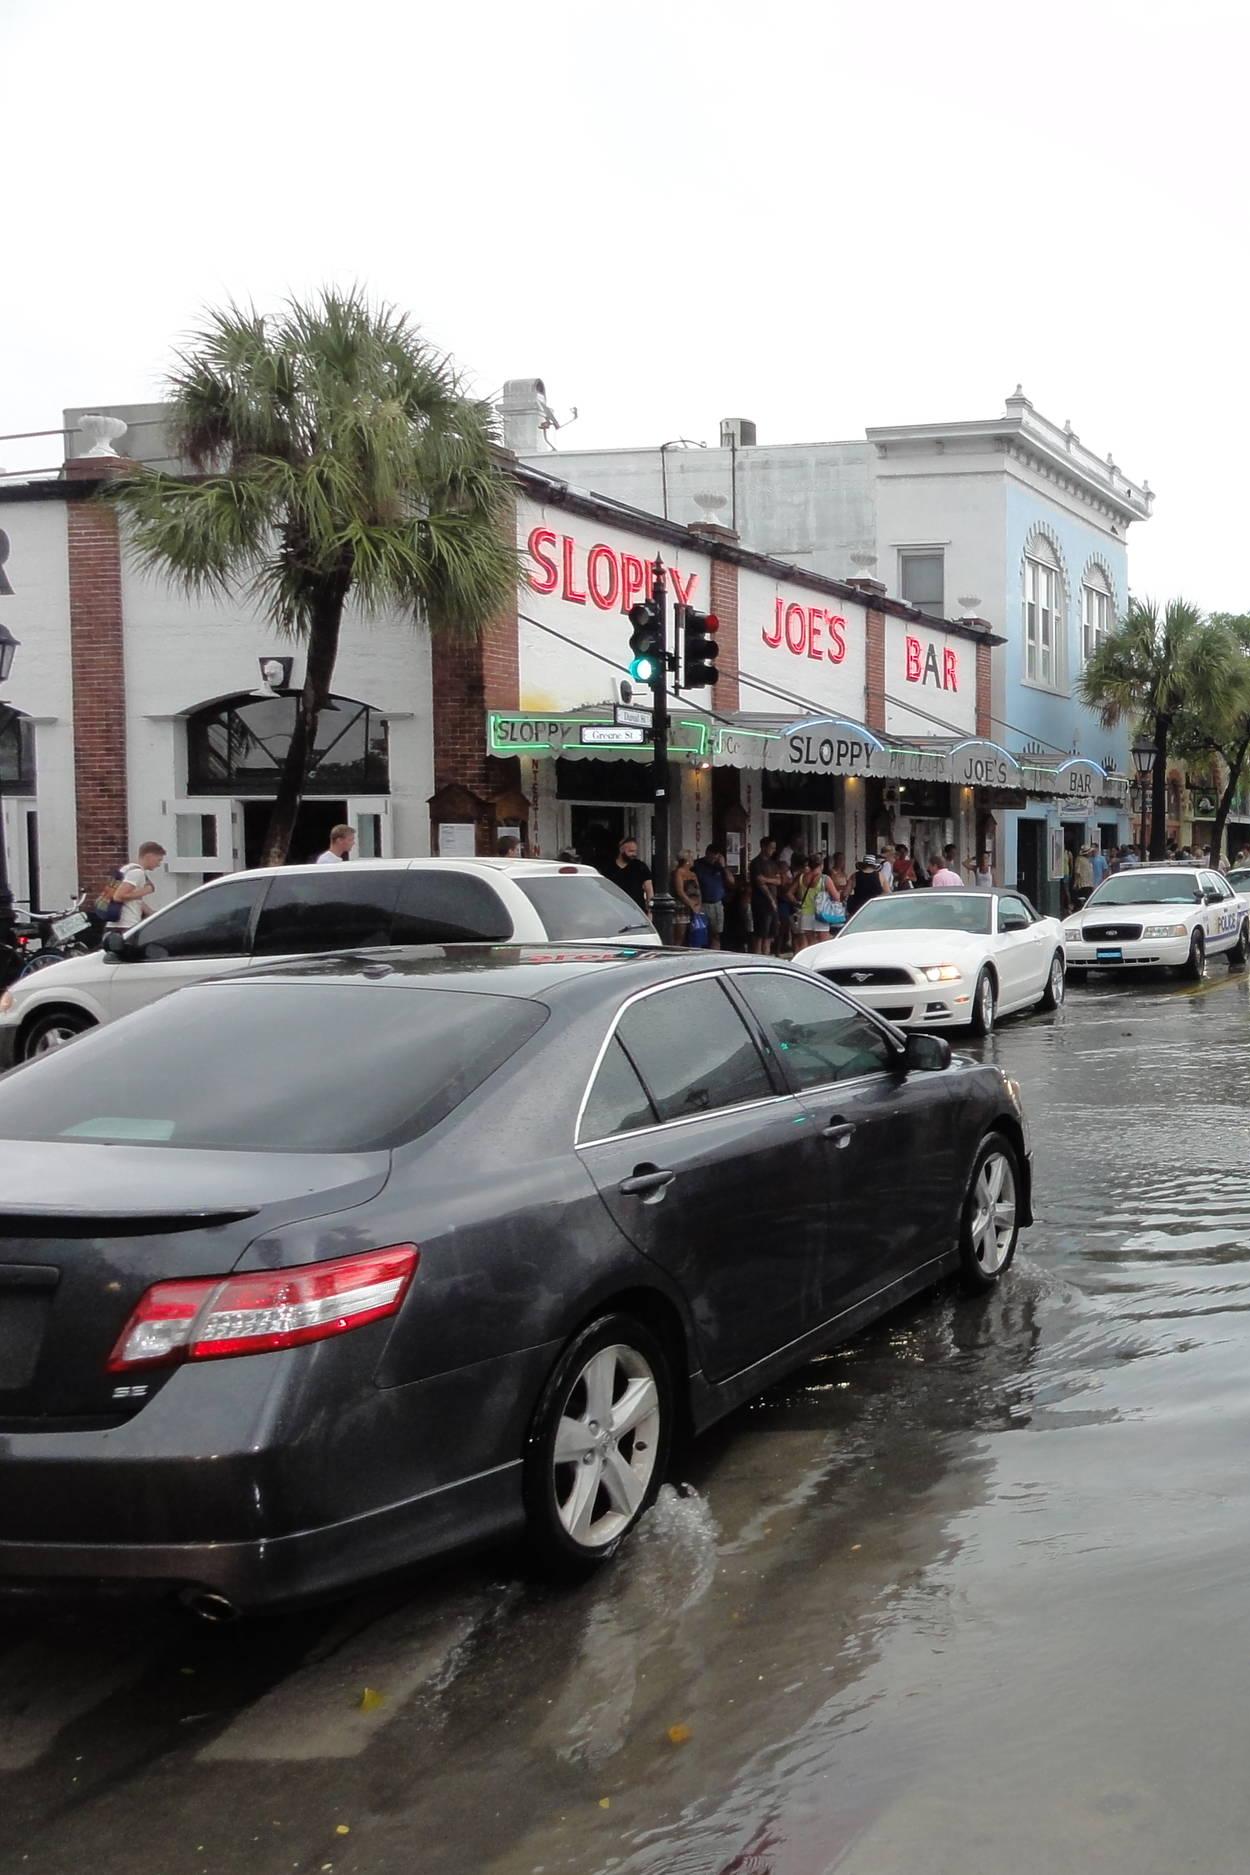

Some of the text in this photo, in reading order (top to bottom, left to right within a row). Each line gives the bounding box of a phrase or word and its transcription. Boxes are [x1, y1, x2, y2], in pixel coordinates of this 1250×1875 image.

[762, 597, 847, 665] JOE'S
[905, 635, 958, 693] BAR
[497, 720, 572, 742] SLOPPY
[592, 731, 633, 740] Greene St
[789, 734, 876, 769] SLOPPY
[964, 757, 1007, 784] JOE'S
[1069, 772, 1092, 793] BAR
[1217, 912, 1236, 934] POLICE
[112, 1385, 149, 1398] SE
